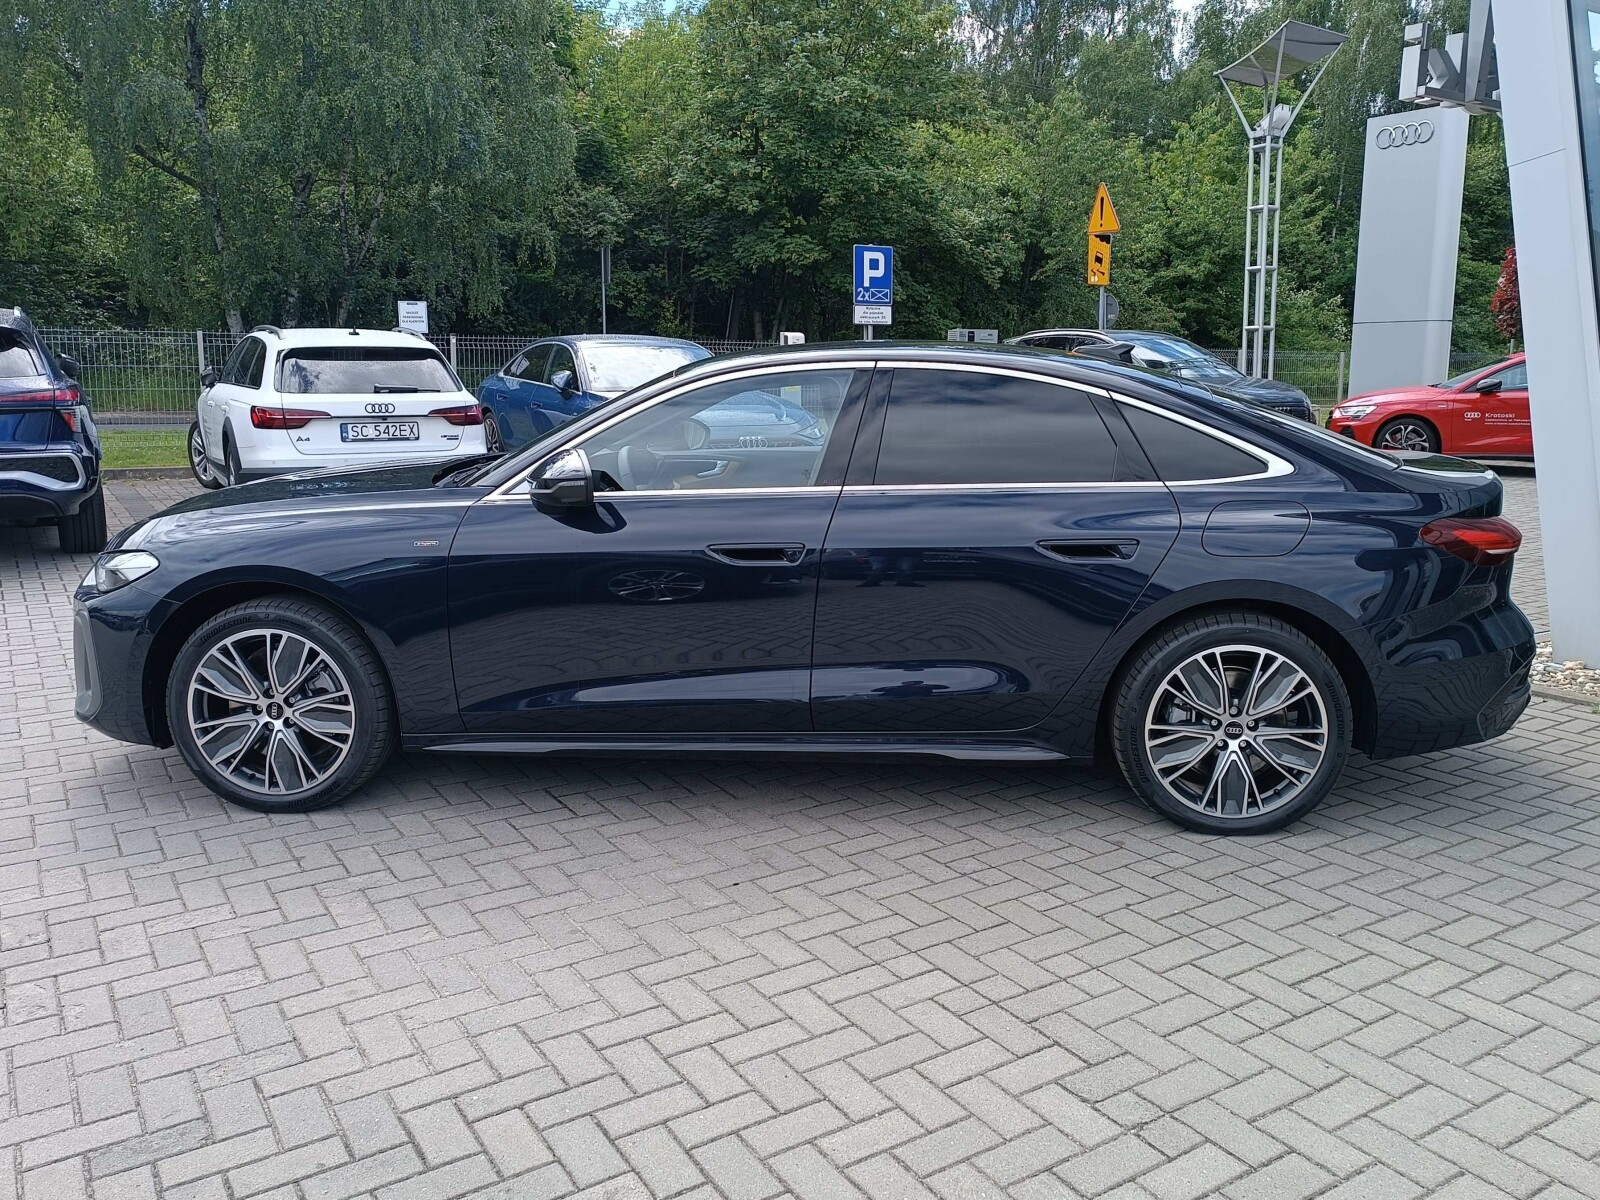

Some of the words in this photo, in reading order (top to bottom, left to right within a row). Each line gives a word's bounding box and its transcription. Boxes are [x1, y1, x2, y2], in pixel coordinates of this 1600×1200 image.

[863, 251, 885, 287] P
[351, 425, 369, 437] SC
[374, 424, 416, 437] 542EX
[200, 616, 252, 644] BRIDGESTONE
[1324, 681, 1345, 740] BRIDGESTONE
[1130, 725, 1150, 784] BRIDGESTONE
